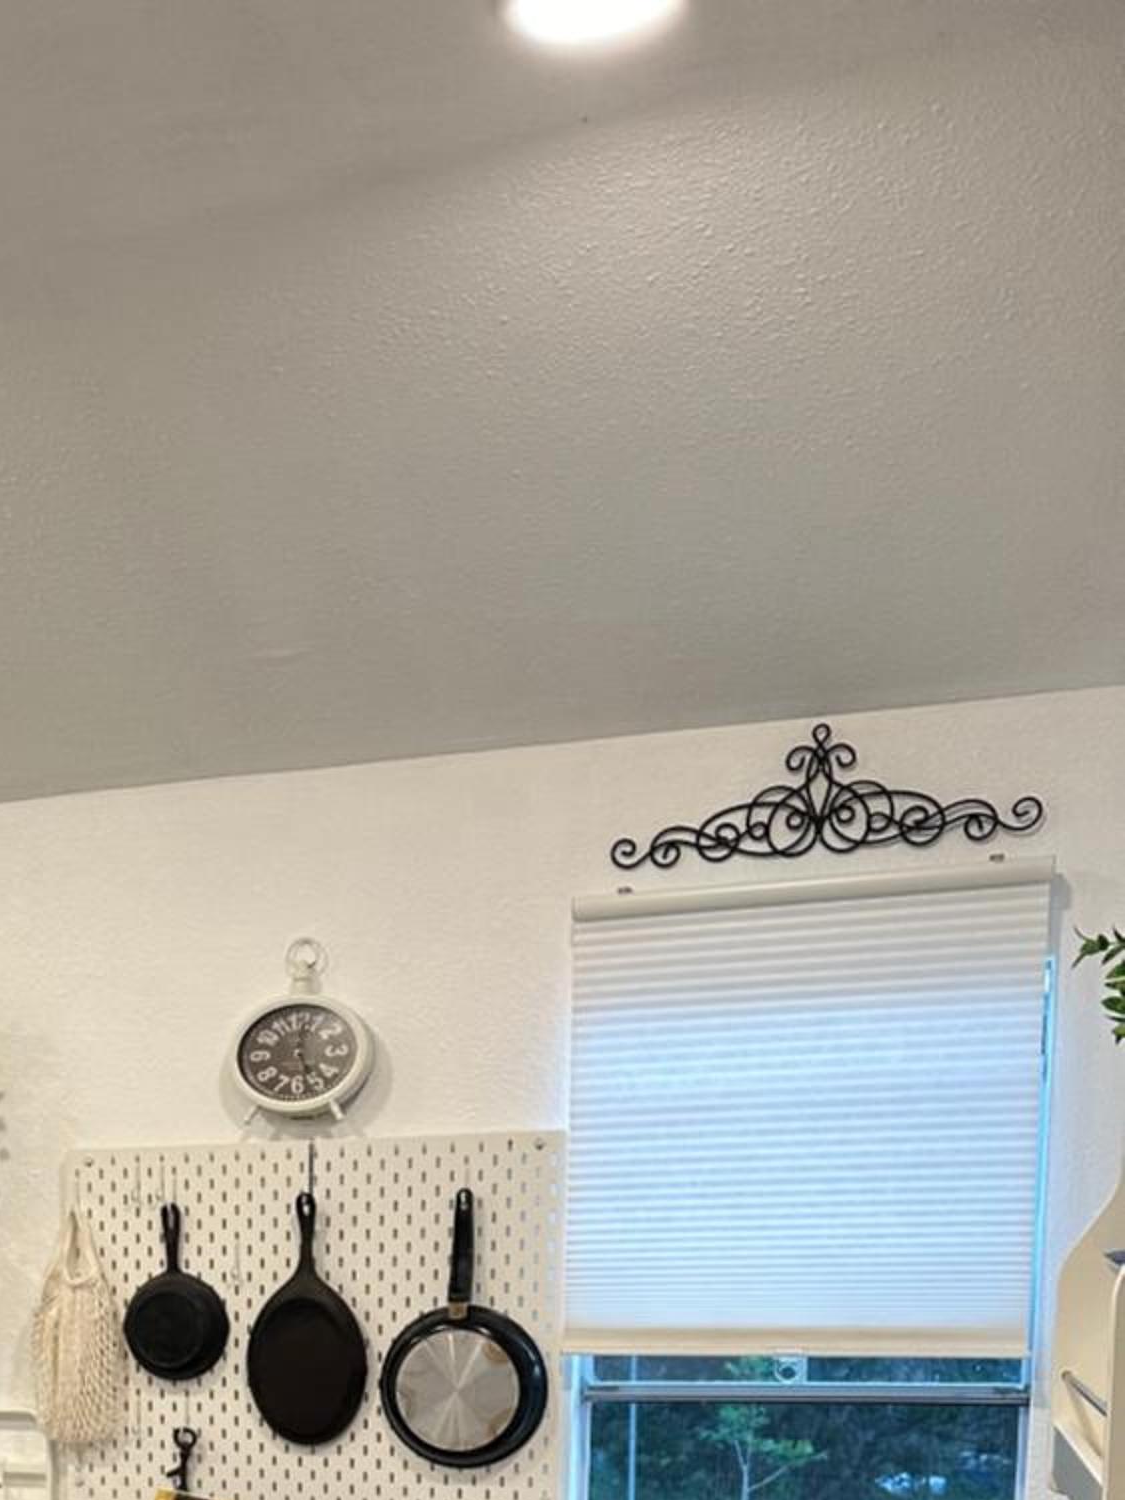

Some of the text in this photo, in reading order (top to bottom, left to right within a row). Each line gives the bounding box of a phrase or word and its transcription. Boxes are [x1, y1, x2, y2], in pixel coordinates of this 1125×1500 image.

[325, 1043, 348, 1057] 3
[257, 1066, 277, 1082] 8
[319, 1062, 339, 1078] 4
[275, 1074, 290, 1092] 7
[291, 1074, 304, 1095] 6
